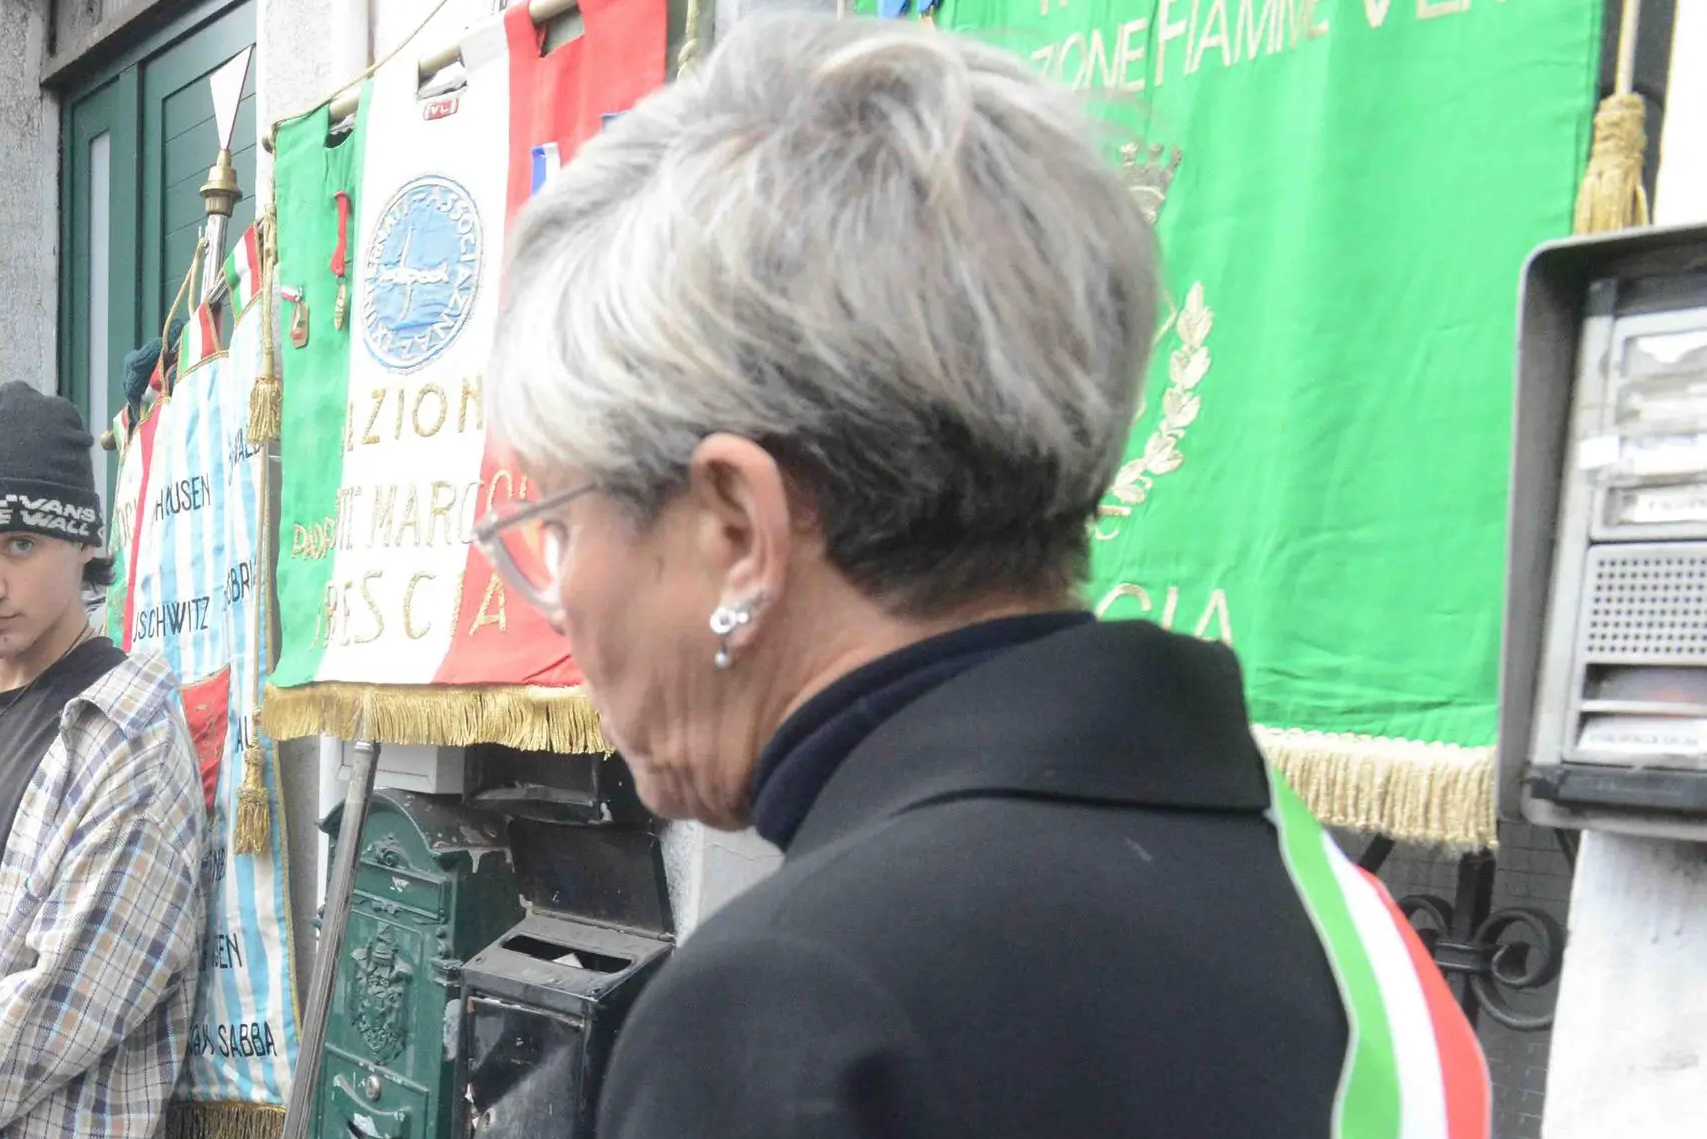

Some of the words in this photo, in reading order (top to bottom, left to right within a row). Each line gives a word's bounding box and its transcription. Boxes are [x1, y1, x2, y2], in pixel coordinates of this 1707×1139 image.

[18, 494, 96, 523] VANS
[20, 509, 90, 536] WALL
[218, 1020, 277, 1058] SABBA
